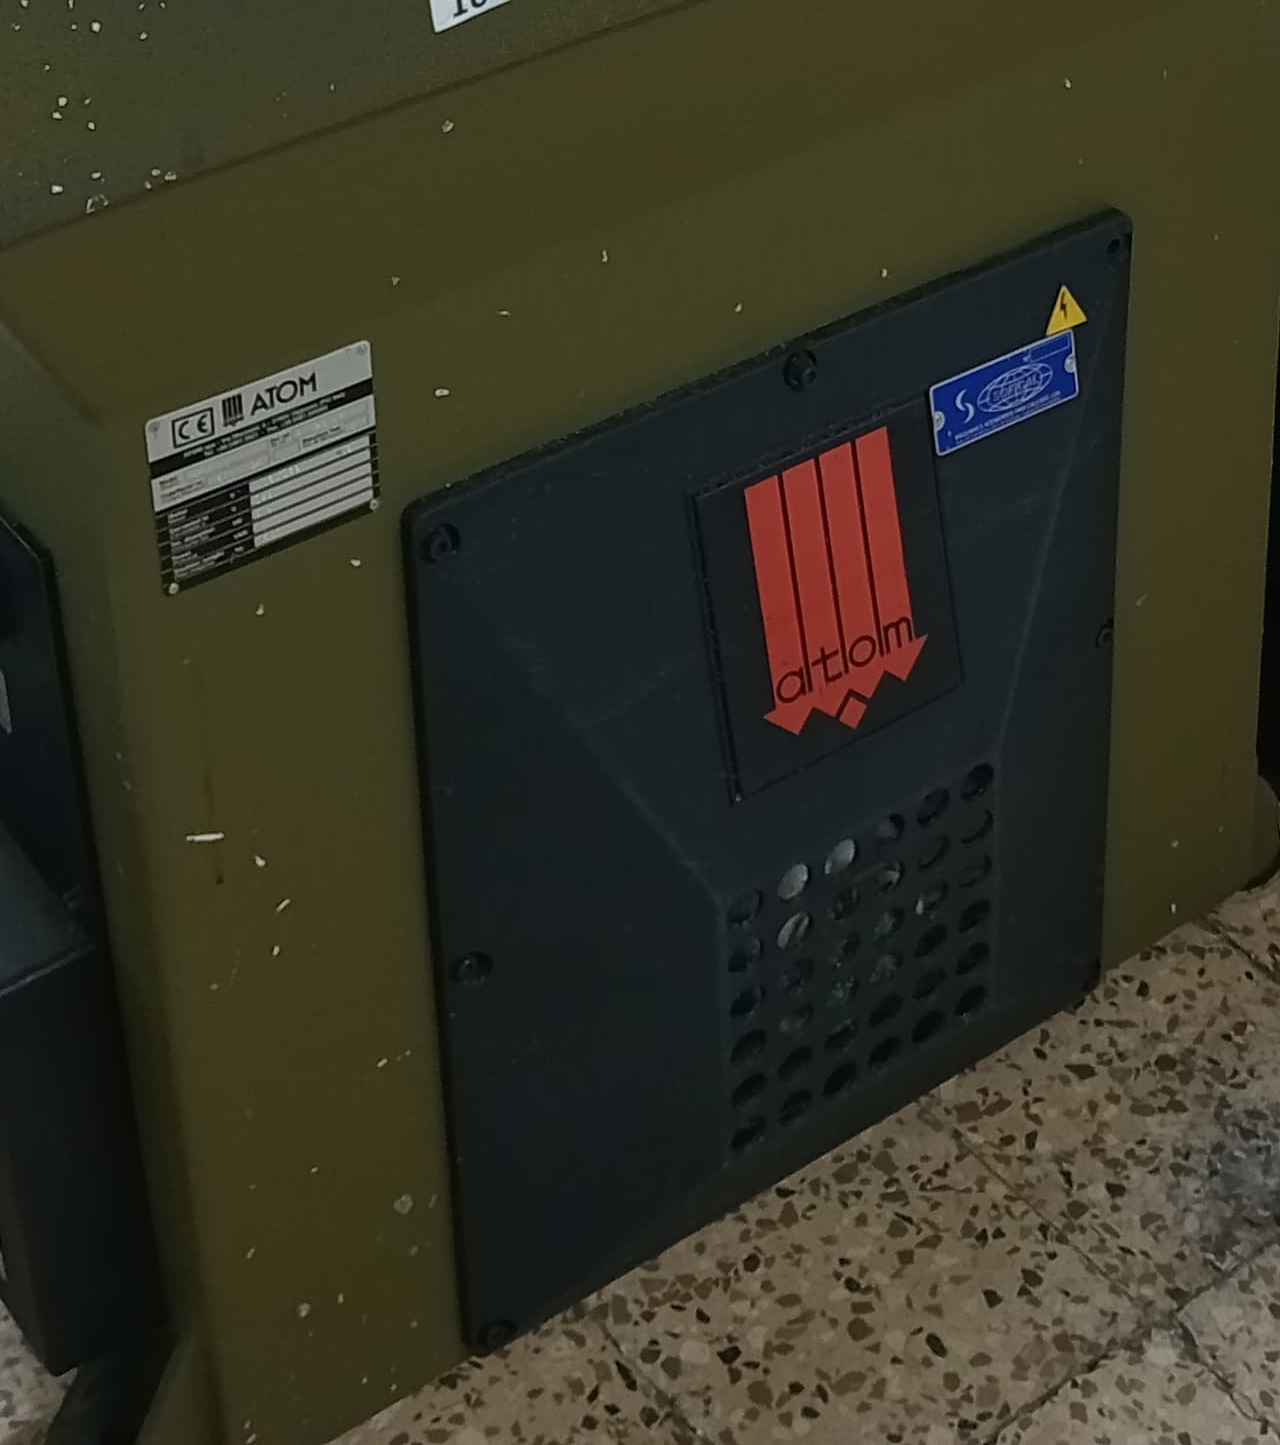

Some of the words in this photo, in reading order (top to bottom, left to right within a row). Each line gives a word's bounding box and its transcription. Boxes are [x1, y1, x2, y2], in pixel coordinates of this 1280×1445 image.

[176, 412, 210, 441] CE
[250, 371, 318, 416] ATOM
[775, 615, 914, 704] atom
